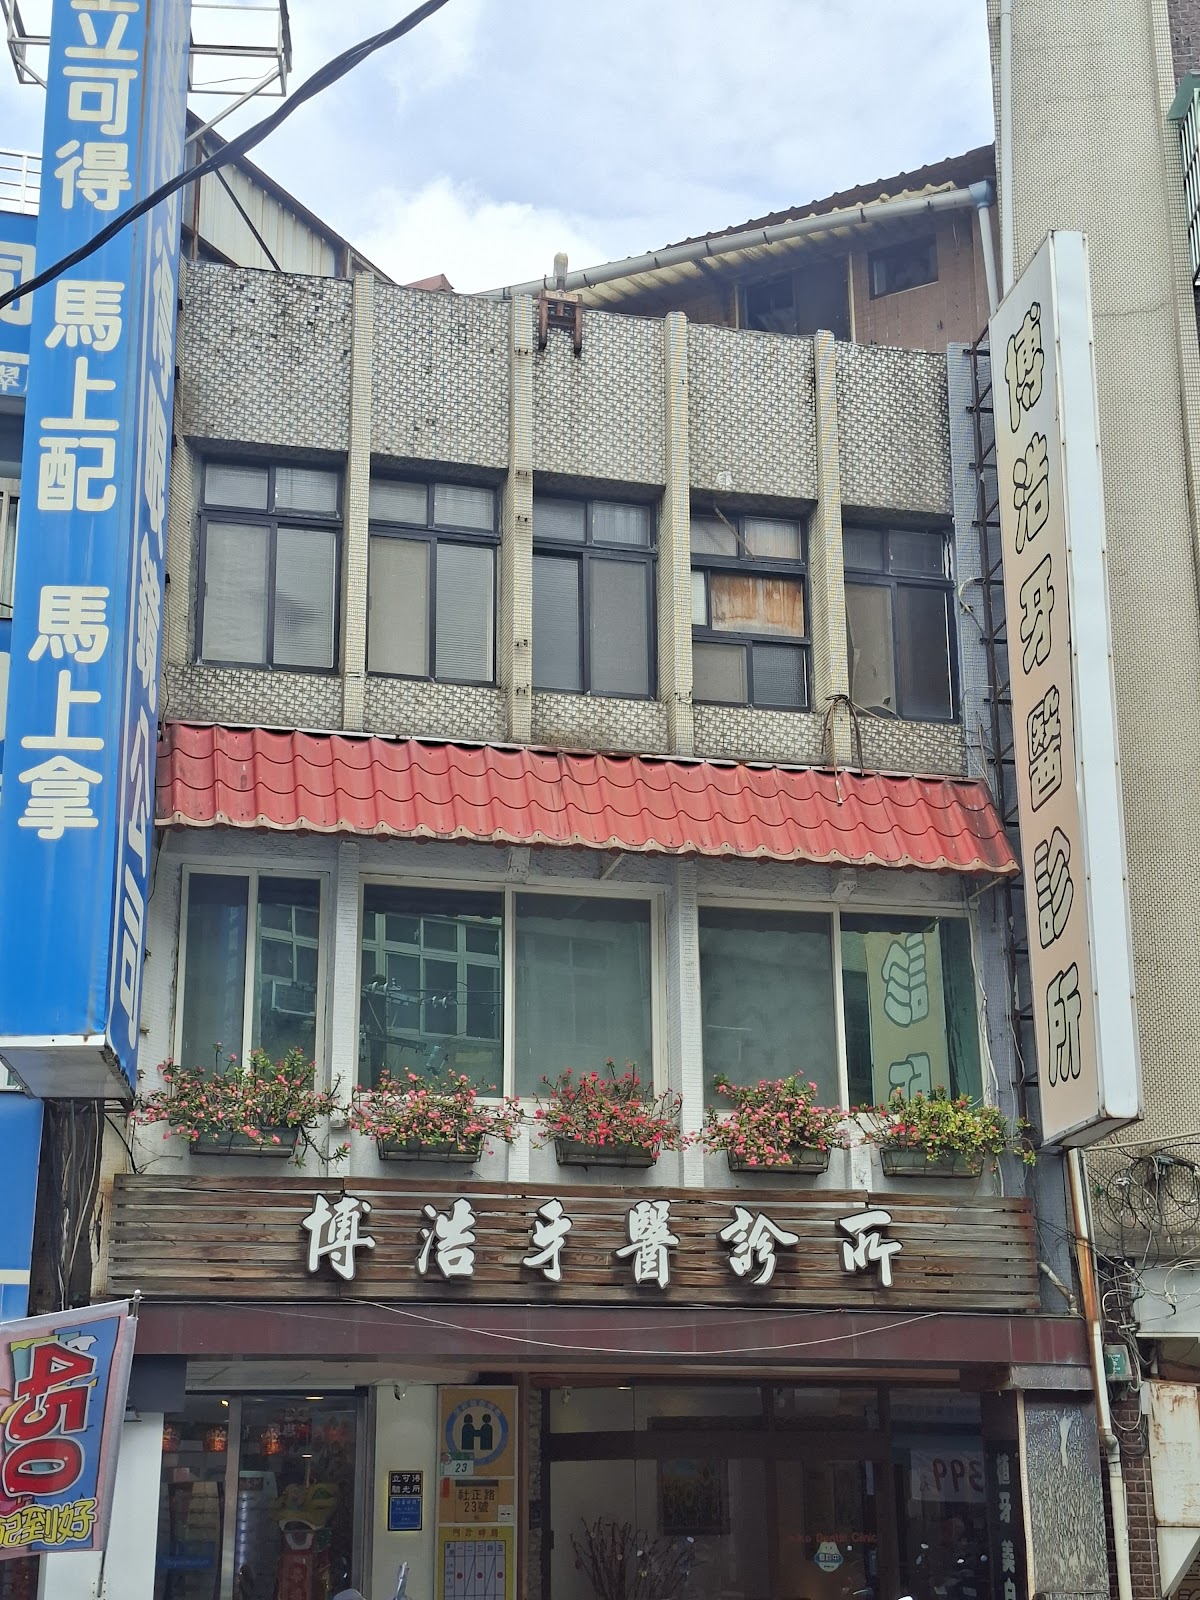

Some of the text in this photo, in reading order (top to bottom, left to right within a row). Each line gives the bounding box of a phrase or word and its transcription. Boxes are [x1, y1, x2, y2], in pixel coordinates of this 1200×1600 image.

[17, 0, 140, 841] 立可得 馬上配 馬上拿
[1006, 302, 1081, 1087] 博浩牙醫診所
[301, 1193, 904, 1290] 博浩牙醫診所
[2, 1340, 98, 1496] 450
[455, 1462, 468, 1473] 23
